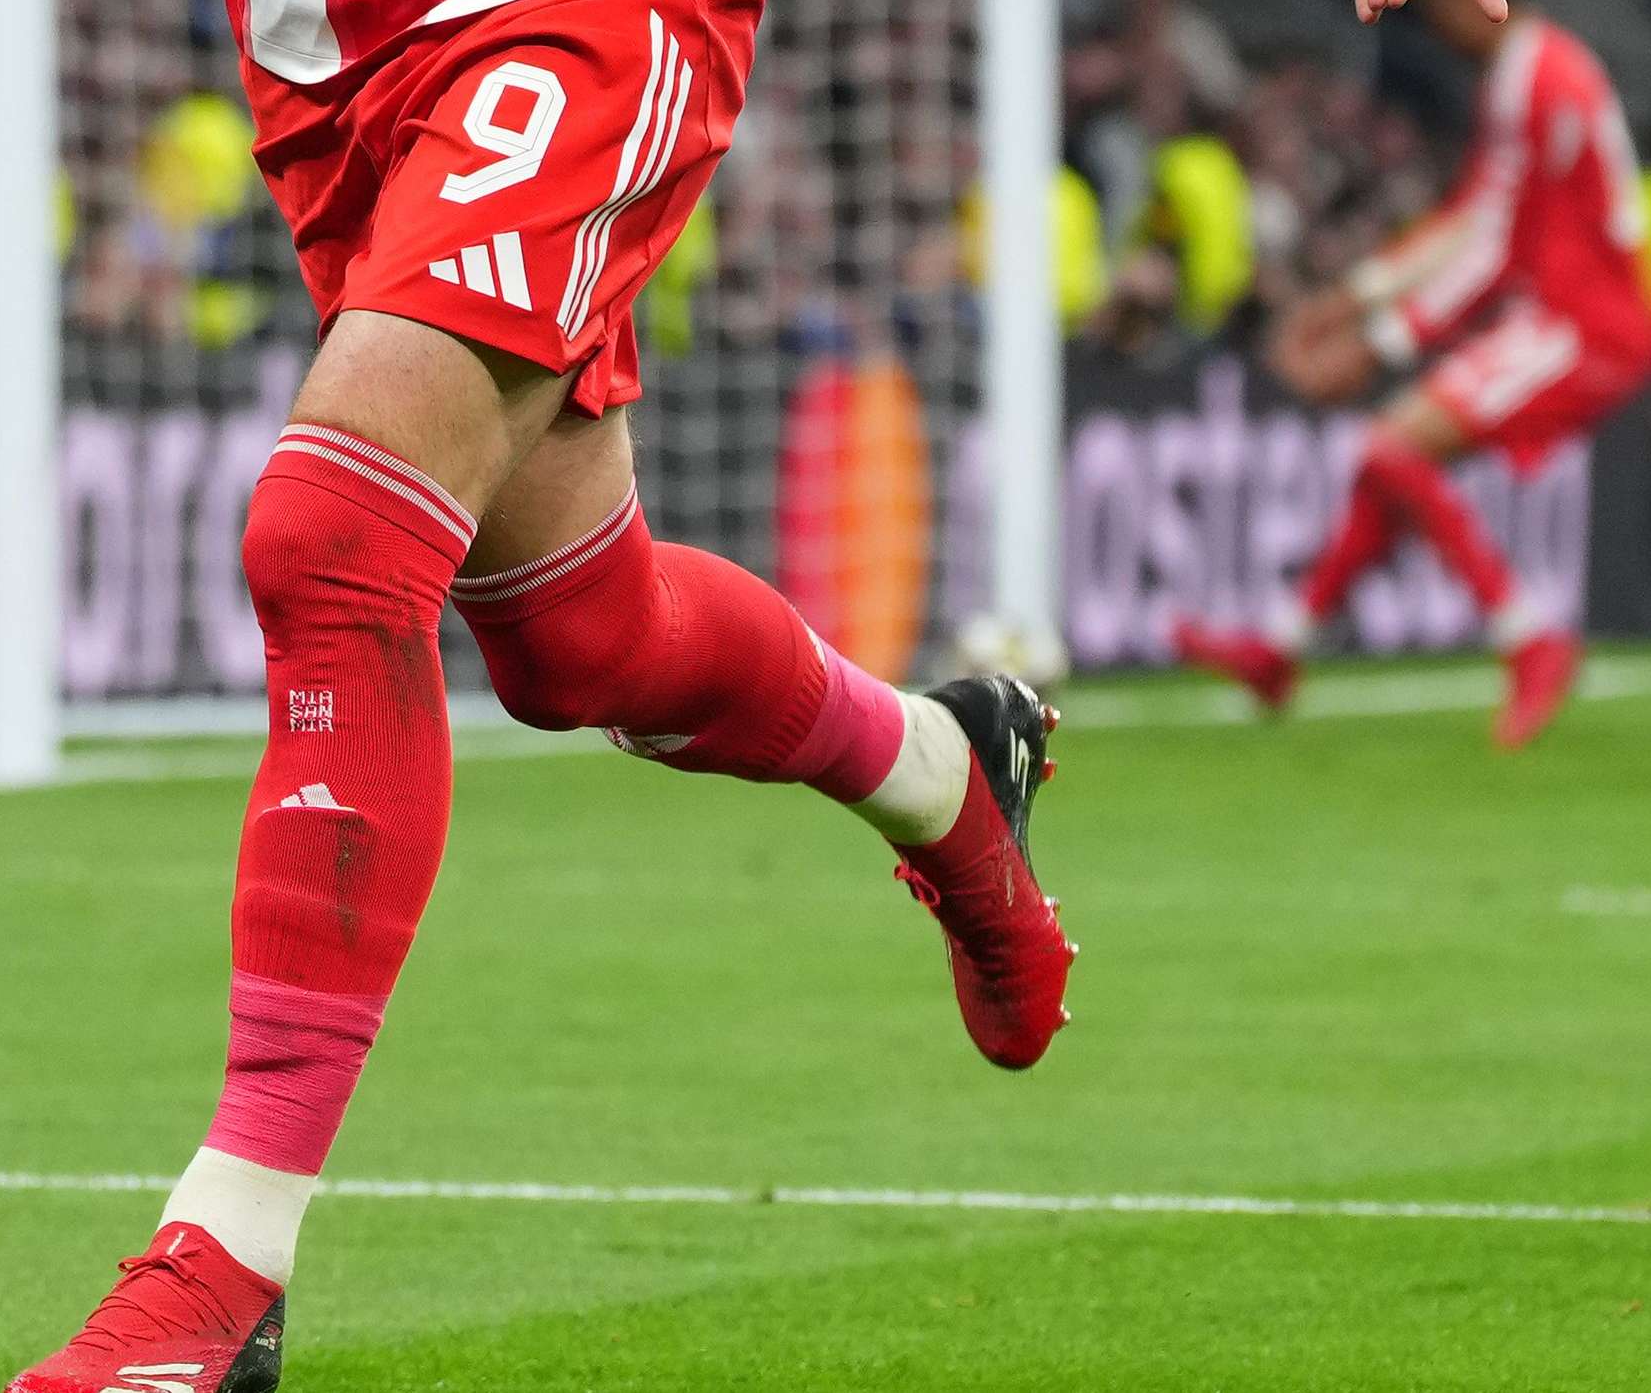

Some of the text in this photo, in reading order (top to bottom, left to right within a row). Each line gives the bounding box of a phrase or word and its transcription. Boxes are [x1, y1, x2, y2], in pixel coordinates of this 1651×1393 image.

[438, 61, 568, 204] 9
[289, 689, 333, 705] MIA
[289, 704, 333, 718] SAN
[289, 717, 334, 733] MIA
